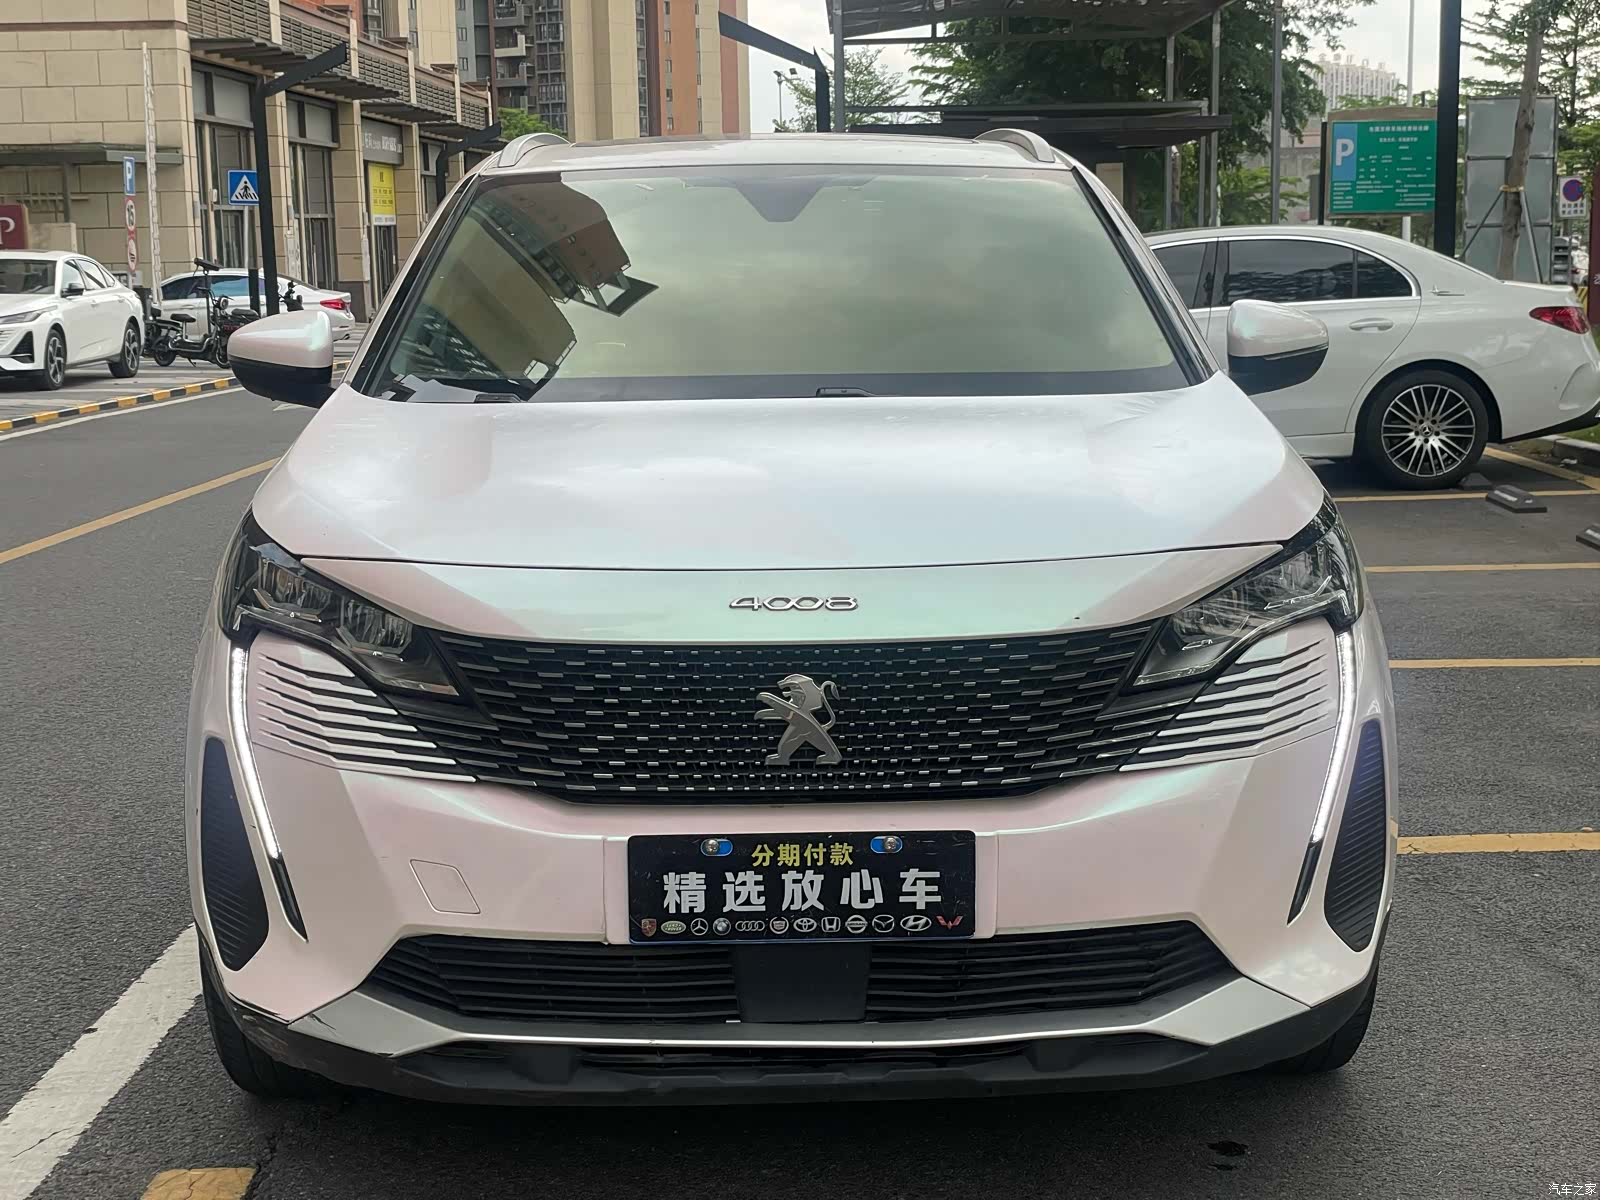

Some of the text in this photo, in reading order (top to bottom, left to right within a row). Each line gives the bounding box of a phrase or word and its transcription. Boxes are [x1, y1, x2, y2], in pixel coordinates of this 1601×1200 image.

[1335, 138, 1355, 166] P
[125, 161, 133, 191] P
[729, 596, 859, 611] 4008
[751, 843, 854, 867] 分期付款
[662, 868, 942, 914] 精选放心车
